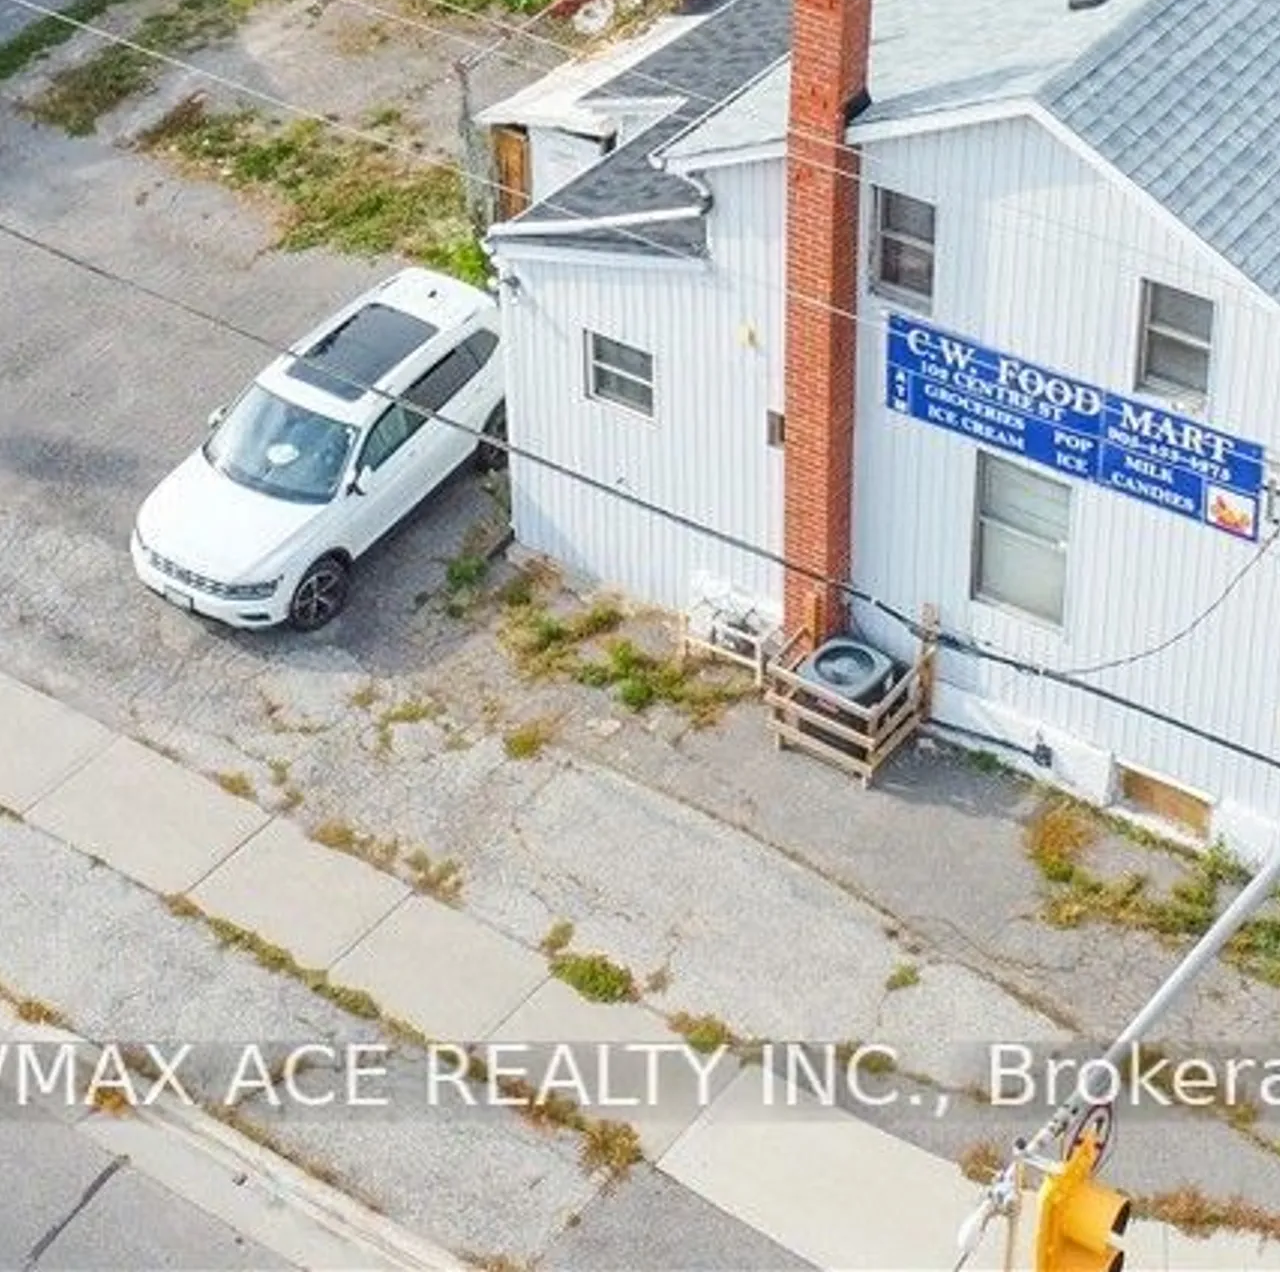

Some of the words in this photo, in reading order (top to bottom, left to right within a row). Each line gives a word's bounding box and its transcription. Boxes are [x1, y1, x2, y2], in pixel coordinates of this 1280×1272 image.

[907, 329, 977, 375] C.W.
[998, 358, 1100, 416] FOOD
[1120, 402, 1235, 463] MART
[924, 384, 1024, 430] GROCERIES
[952, 371, 1033, 413] CENTRE
[1039, 401, 1067, 422] ST
[927, 404, 959, 427] ICE
[960, 416, 1025, 451] CREAM
[1053, 428, 1094, 453] POP
[1056, 450, 1089, 474] ICE
[1124, 455, 1173, 485] MILK
[1111, 471, 1195, 512] CANDIES
